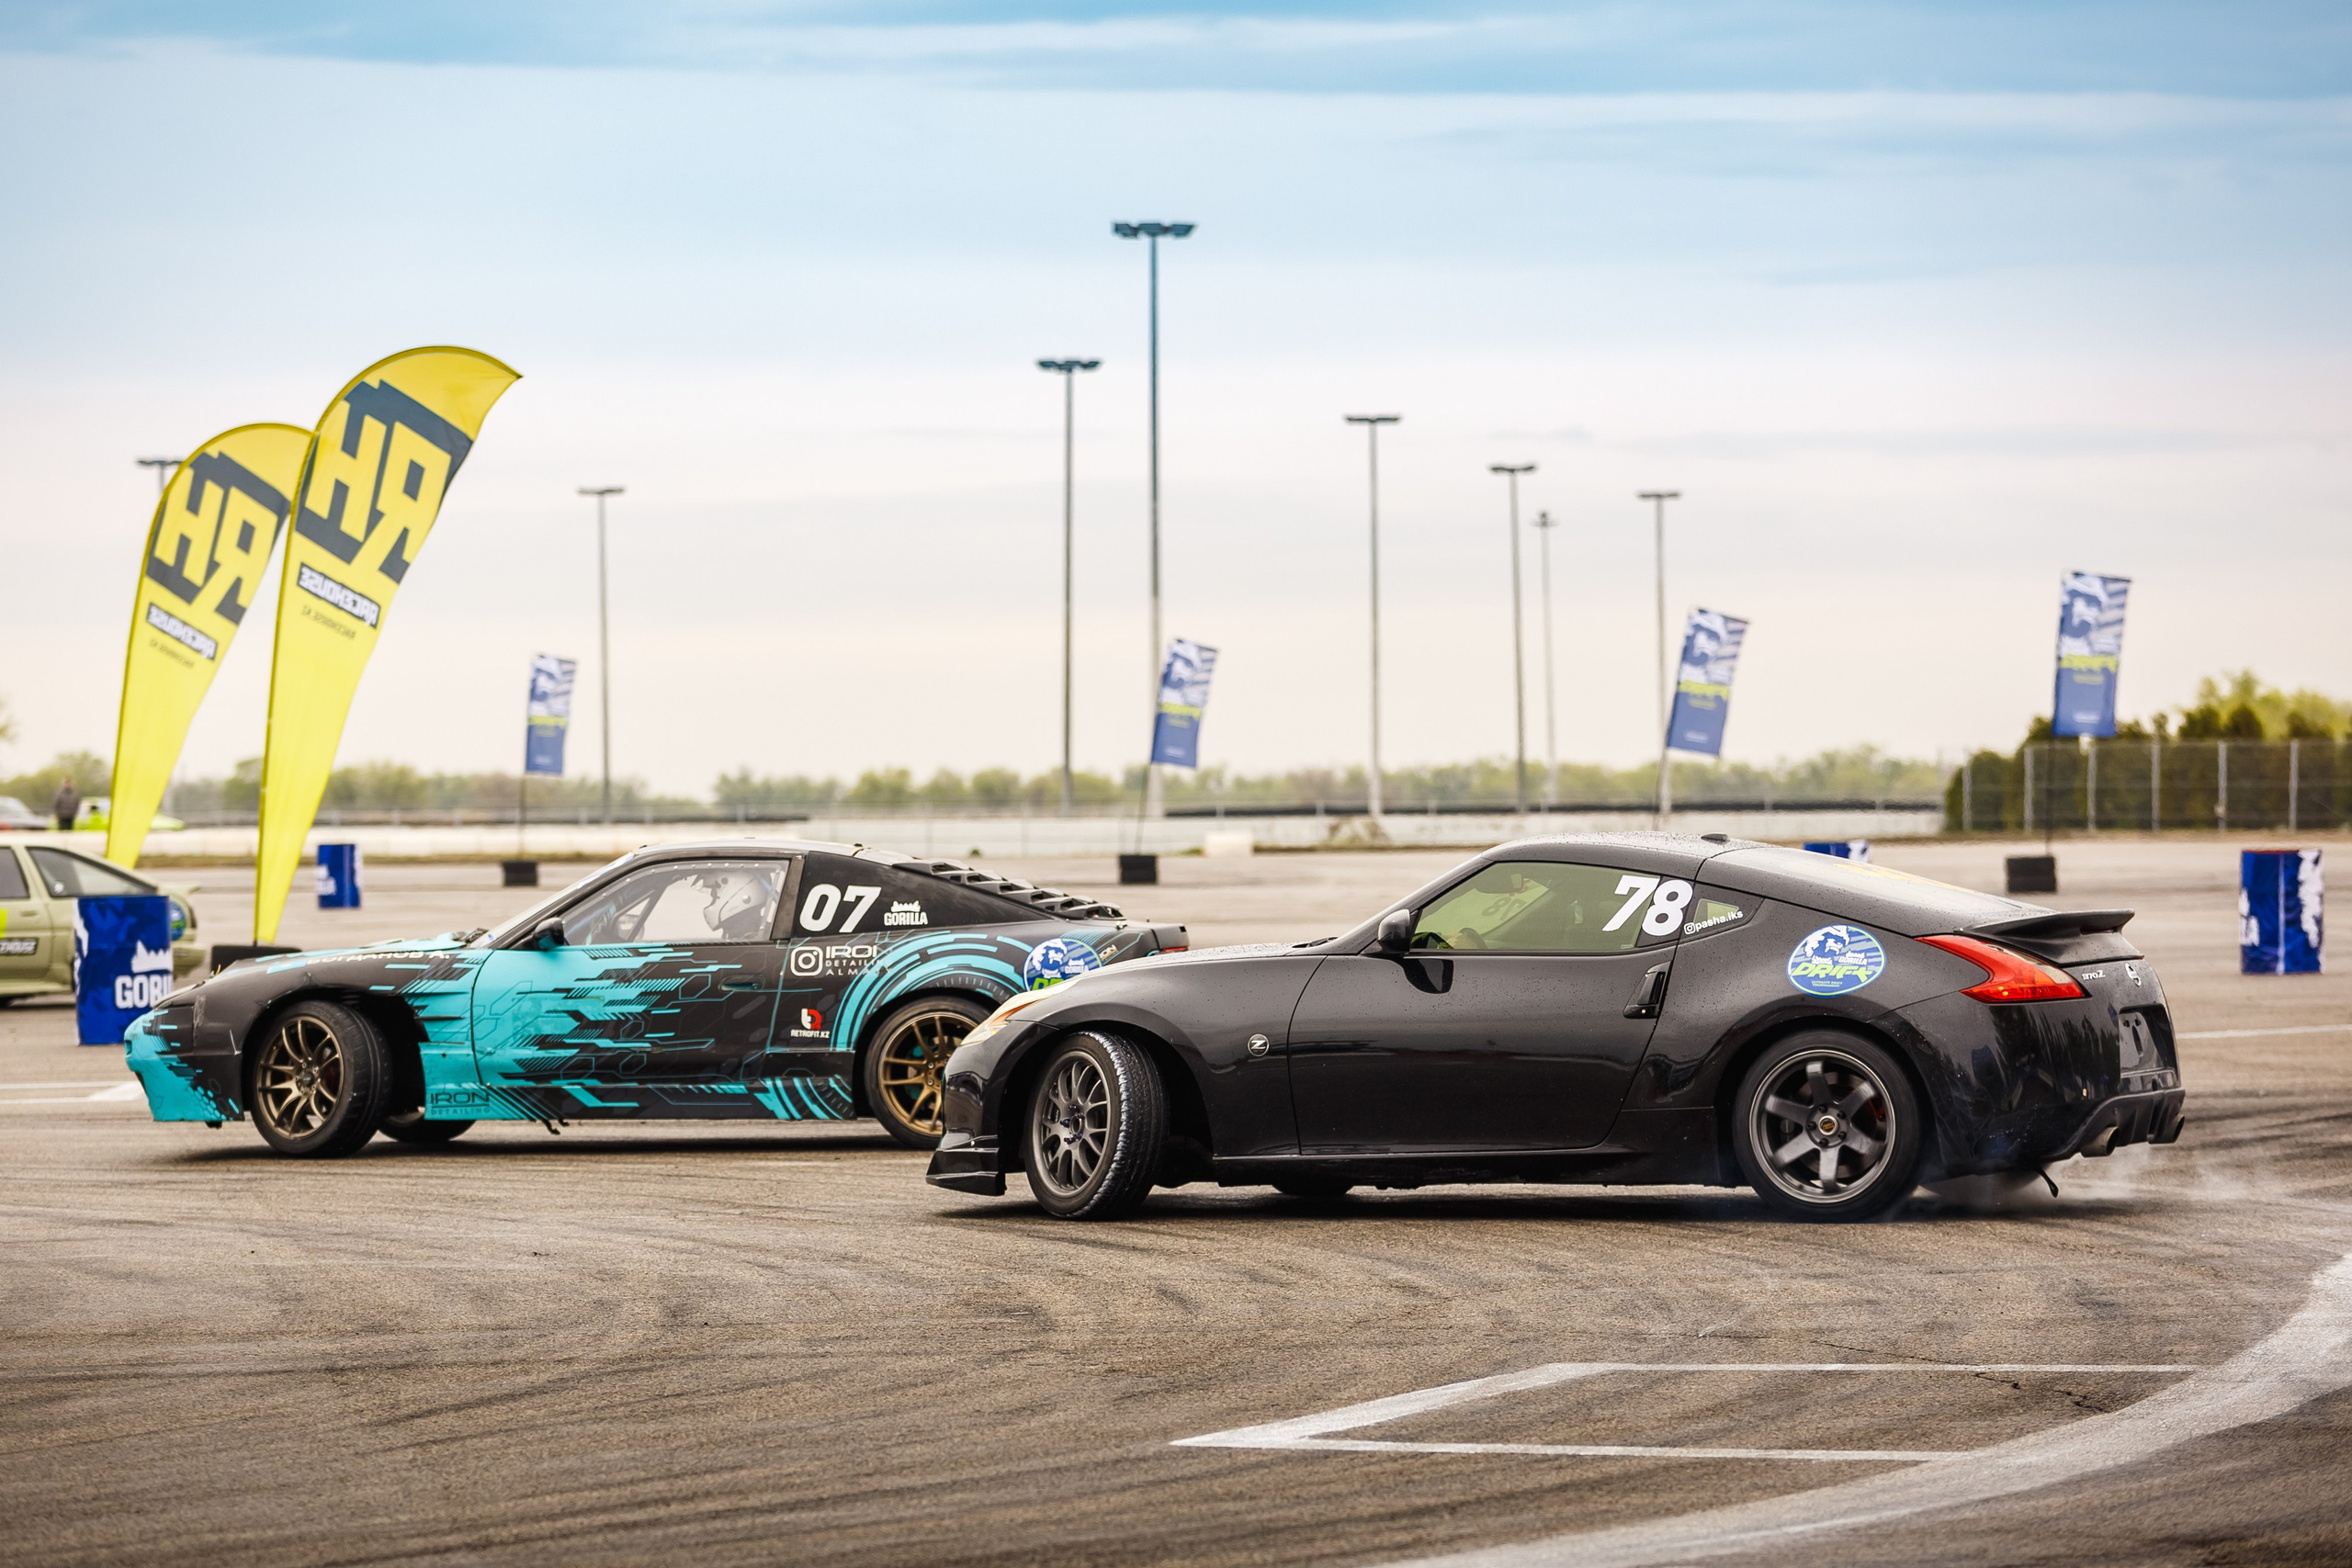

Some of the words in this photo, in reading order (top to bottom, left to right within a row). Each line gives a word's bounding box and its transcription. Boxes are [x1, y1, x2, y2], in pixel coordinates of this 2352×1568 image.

[799, 883, 882, 933] 07
[1602, 874, 1693, 936] 78
[884, 912, 928, 926] GORILLA
[1838, 956, 1867, 965] GORILLA
[1791, 962, 1873, 983] DRIFT
[1250, 1040, 1266, 1050] Z
[430, 1092, 489, 1104] IRON
[431, 1108, 491, 1116] DETAILING
